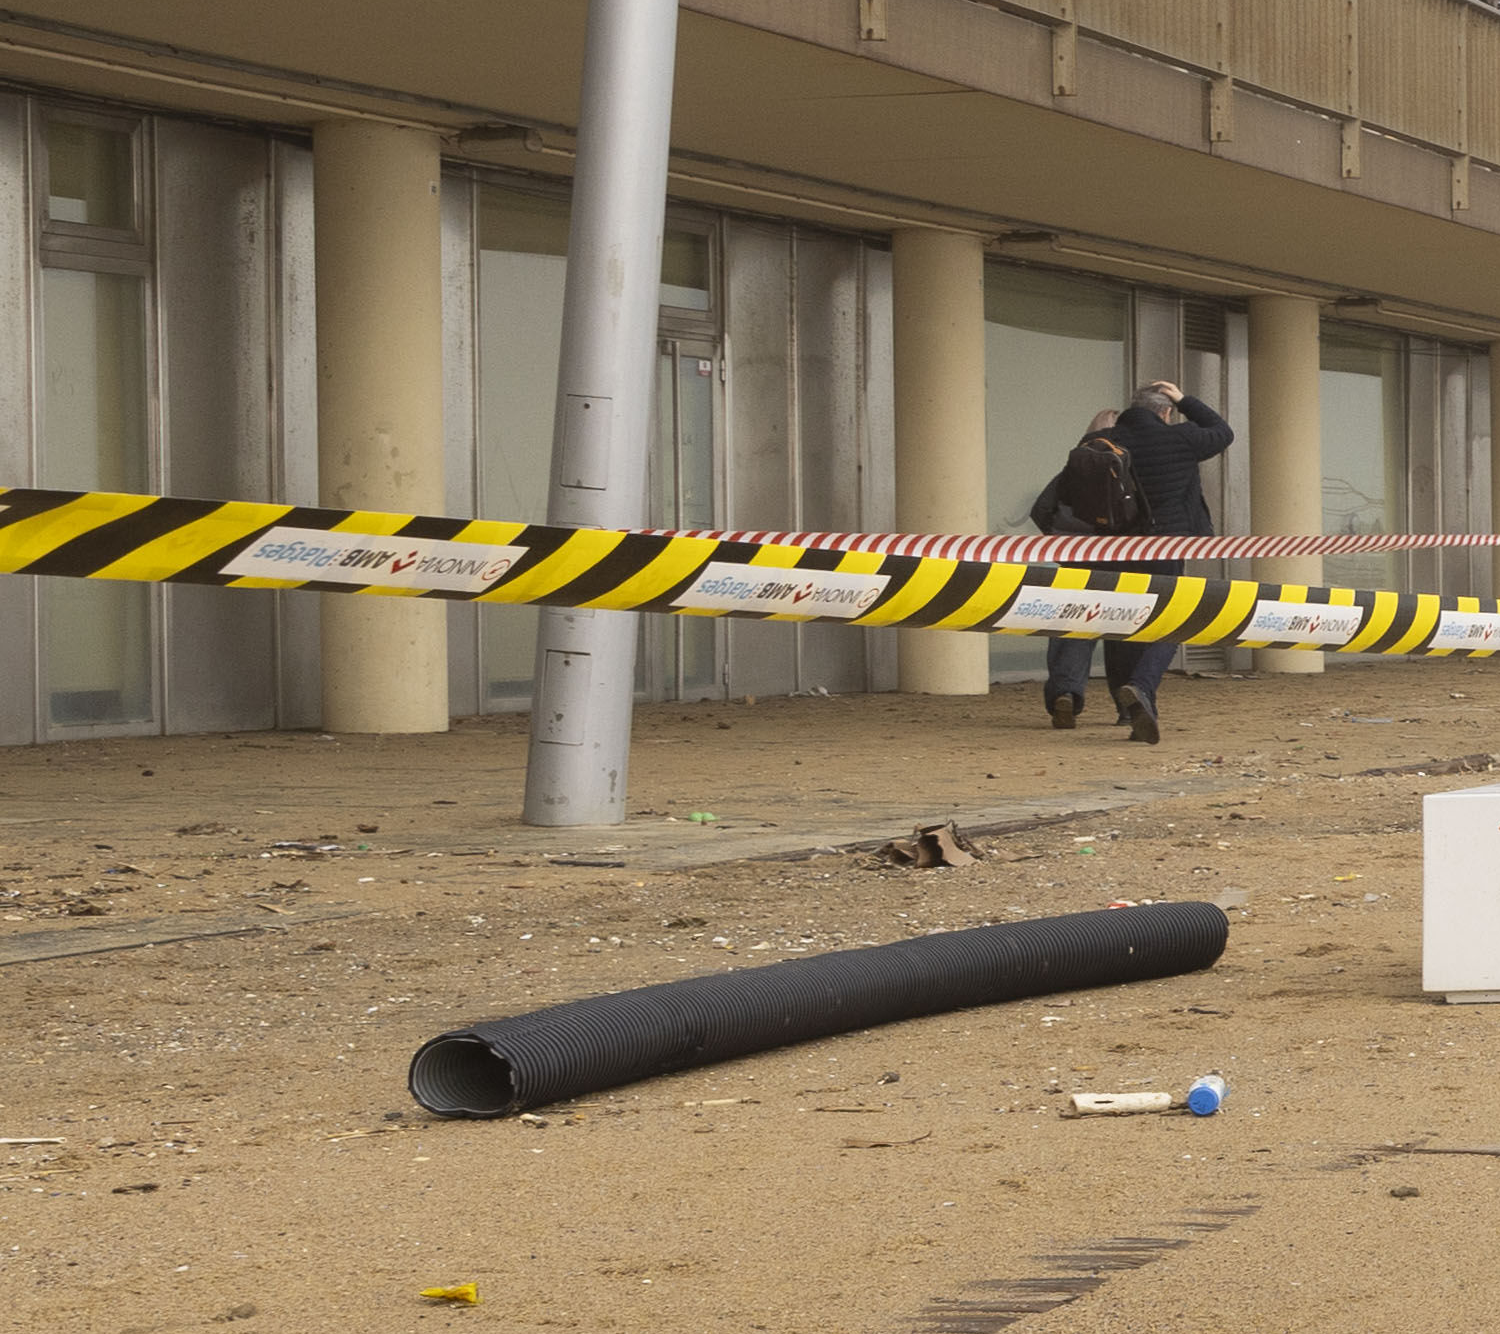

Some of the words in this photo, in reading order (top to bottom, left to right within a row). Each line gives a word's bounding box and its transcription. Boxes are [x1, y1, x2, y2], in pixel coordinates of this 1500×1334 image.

[254, 541, 335, 567] Platges
[340, 548, 397, 569] AMB
[697, 576, 756, 599] Platges
[758, 581, 798, 599] AMB
[1014, 599, 1058, 619] Platges
[1059, 603, 1088, 619] AMB
